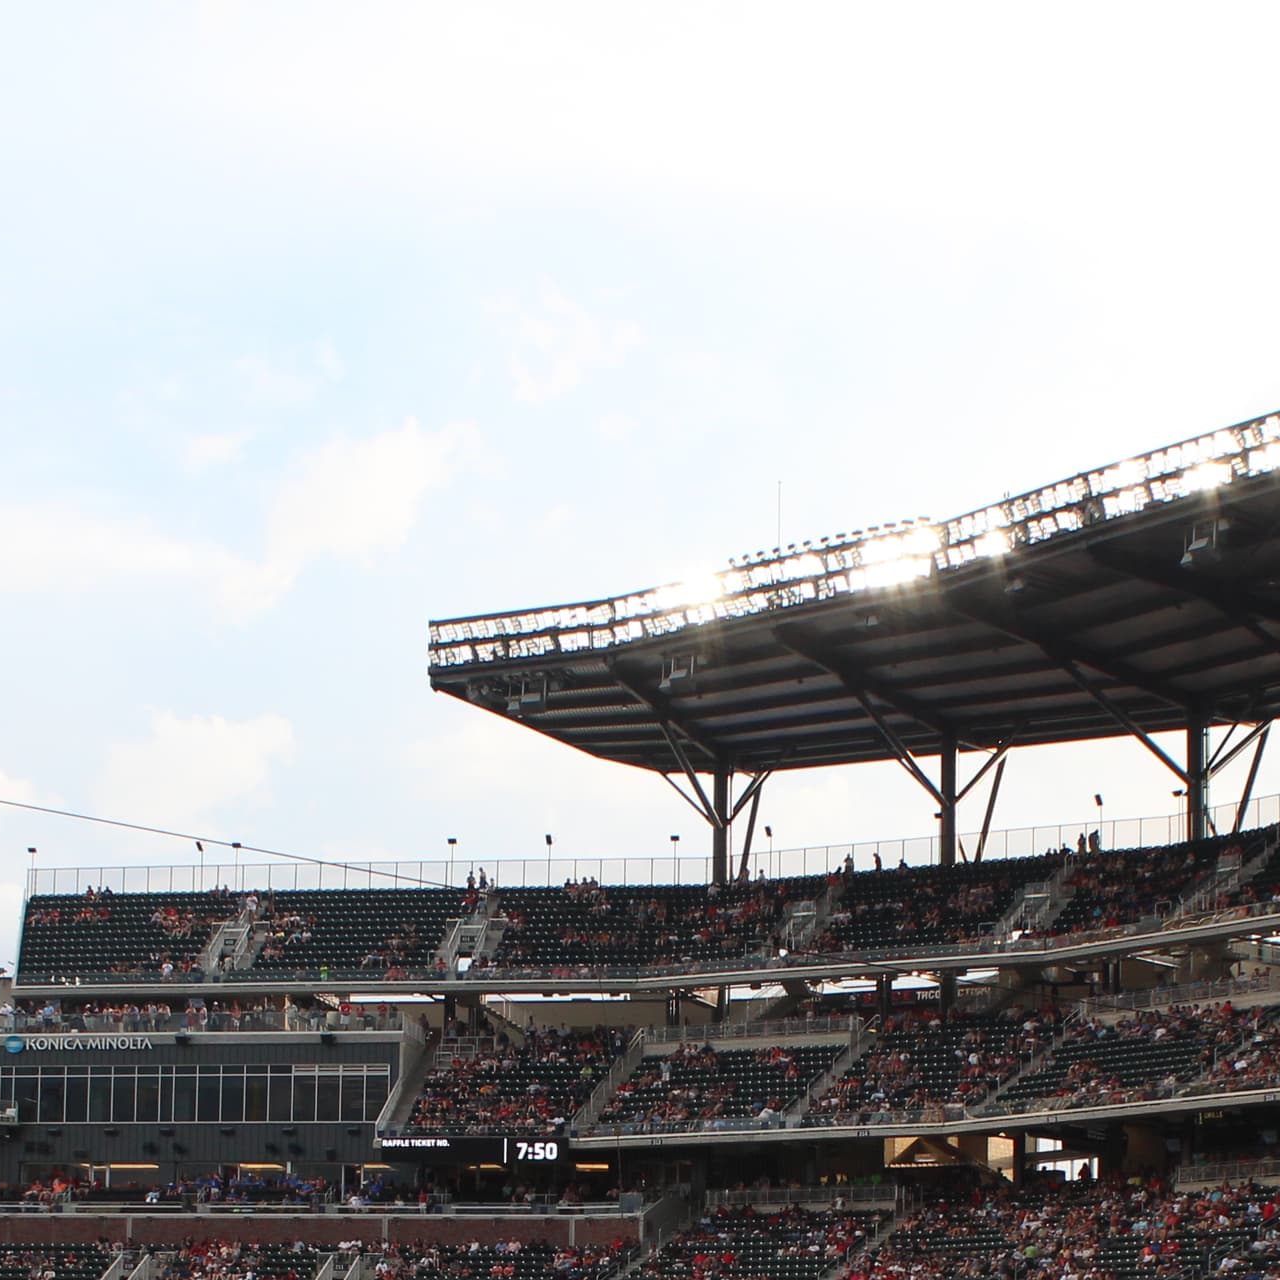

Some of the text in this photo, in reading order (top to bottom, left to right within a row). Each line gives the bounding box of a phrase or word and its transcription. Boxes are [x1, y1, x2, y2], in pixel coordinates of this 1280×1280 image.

[26, 1037, 153, 1050] KONICA MINOLTA
[382, 1139, 409, 1147] RAFFLE
[410, 1139, 436, 1147] TICKET
[516, 1142, 558, 1160] 7:50
